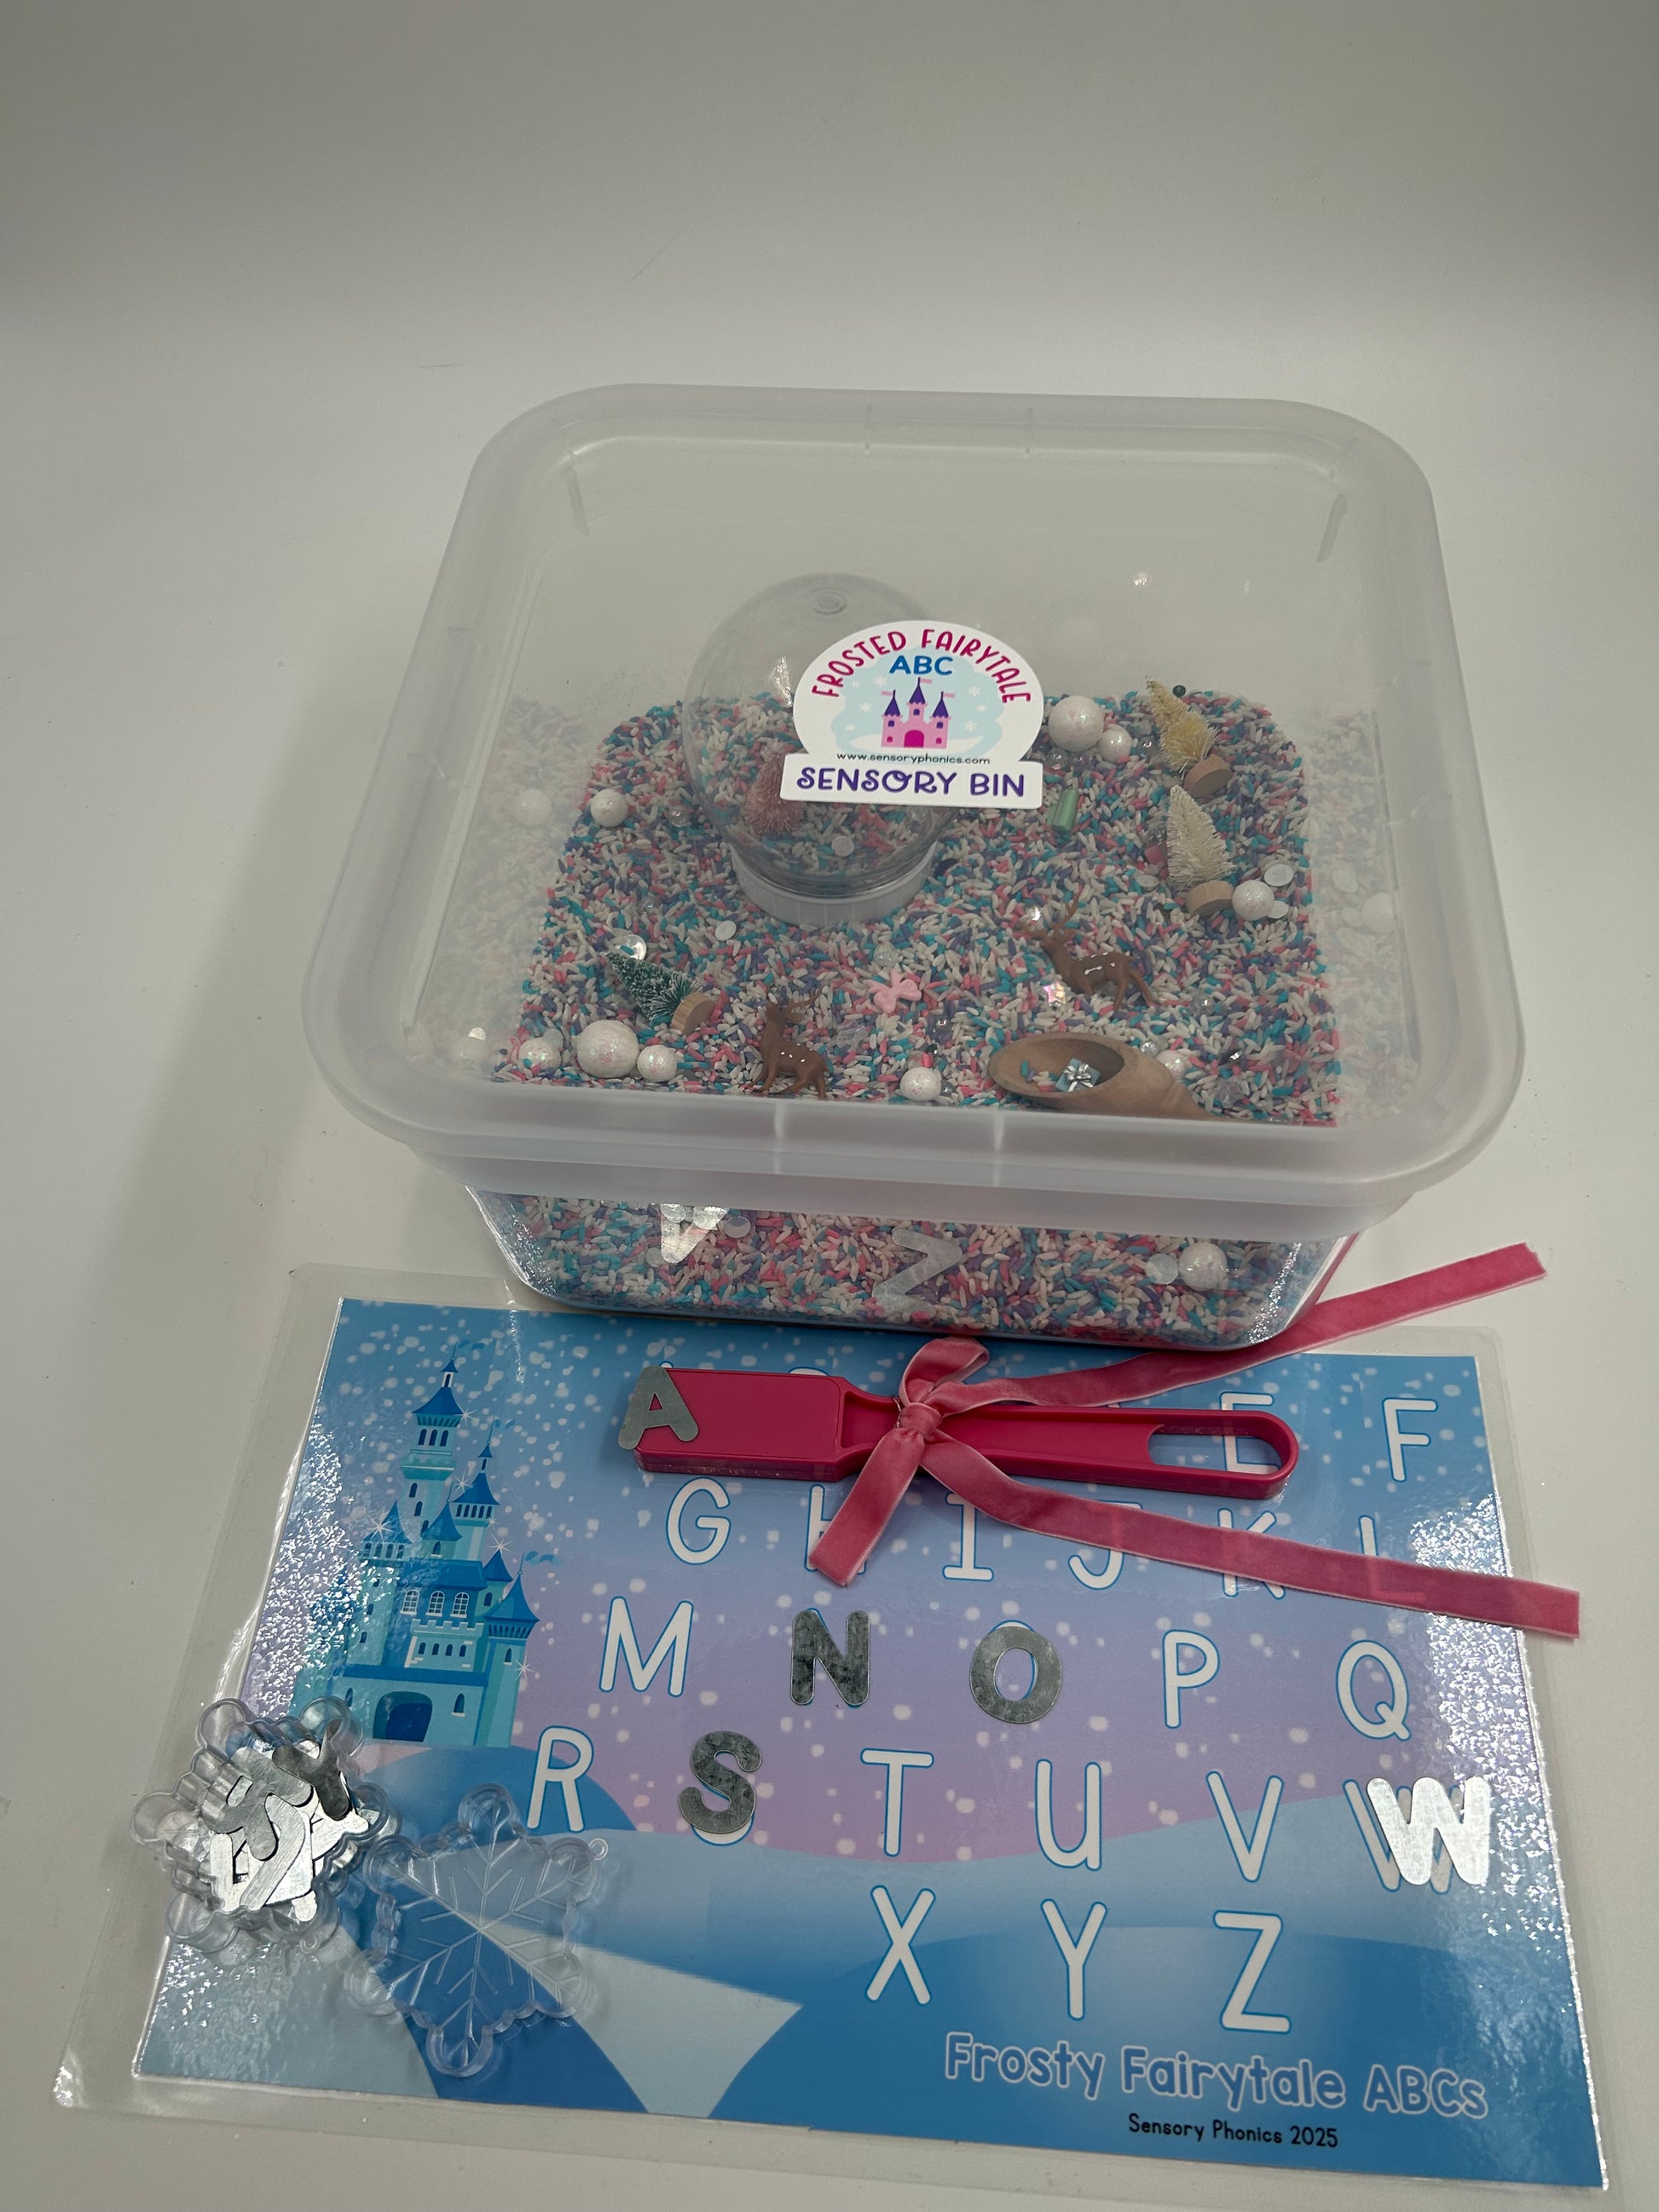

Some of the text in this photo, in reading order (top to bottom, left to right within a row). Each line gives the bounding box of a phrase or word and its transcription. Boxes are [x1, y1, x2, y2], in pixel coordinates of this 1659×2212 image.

[812, 629, 1032, 704] FROSTED FAIRYTALE
[889, 656, 954, 676] ABC
[796, 767, 1025, 798] SENSORY BIN
[836, 753, 991, 765] www.sensoryphonics.com
[618, 1366, 699, 1449] A
[1382, 1397, 1438, 1482] F
[666, 1477, 731, 1565] G
[942, 1493, 994, 1581] I
[599, 1597, 1411, 1741] M N O P Q
[526, 1725, 1492, 1886] R S T U V W
[866, 1885, 1291, 2034] X Y Z
[945, 2031, 1488, 2120] Frosty Fairytale ABCs
[1128, 2113, 1338, 2147] Sensory Phonics 2025
